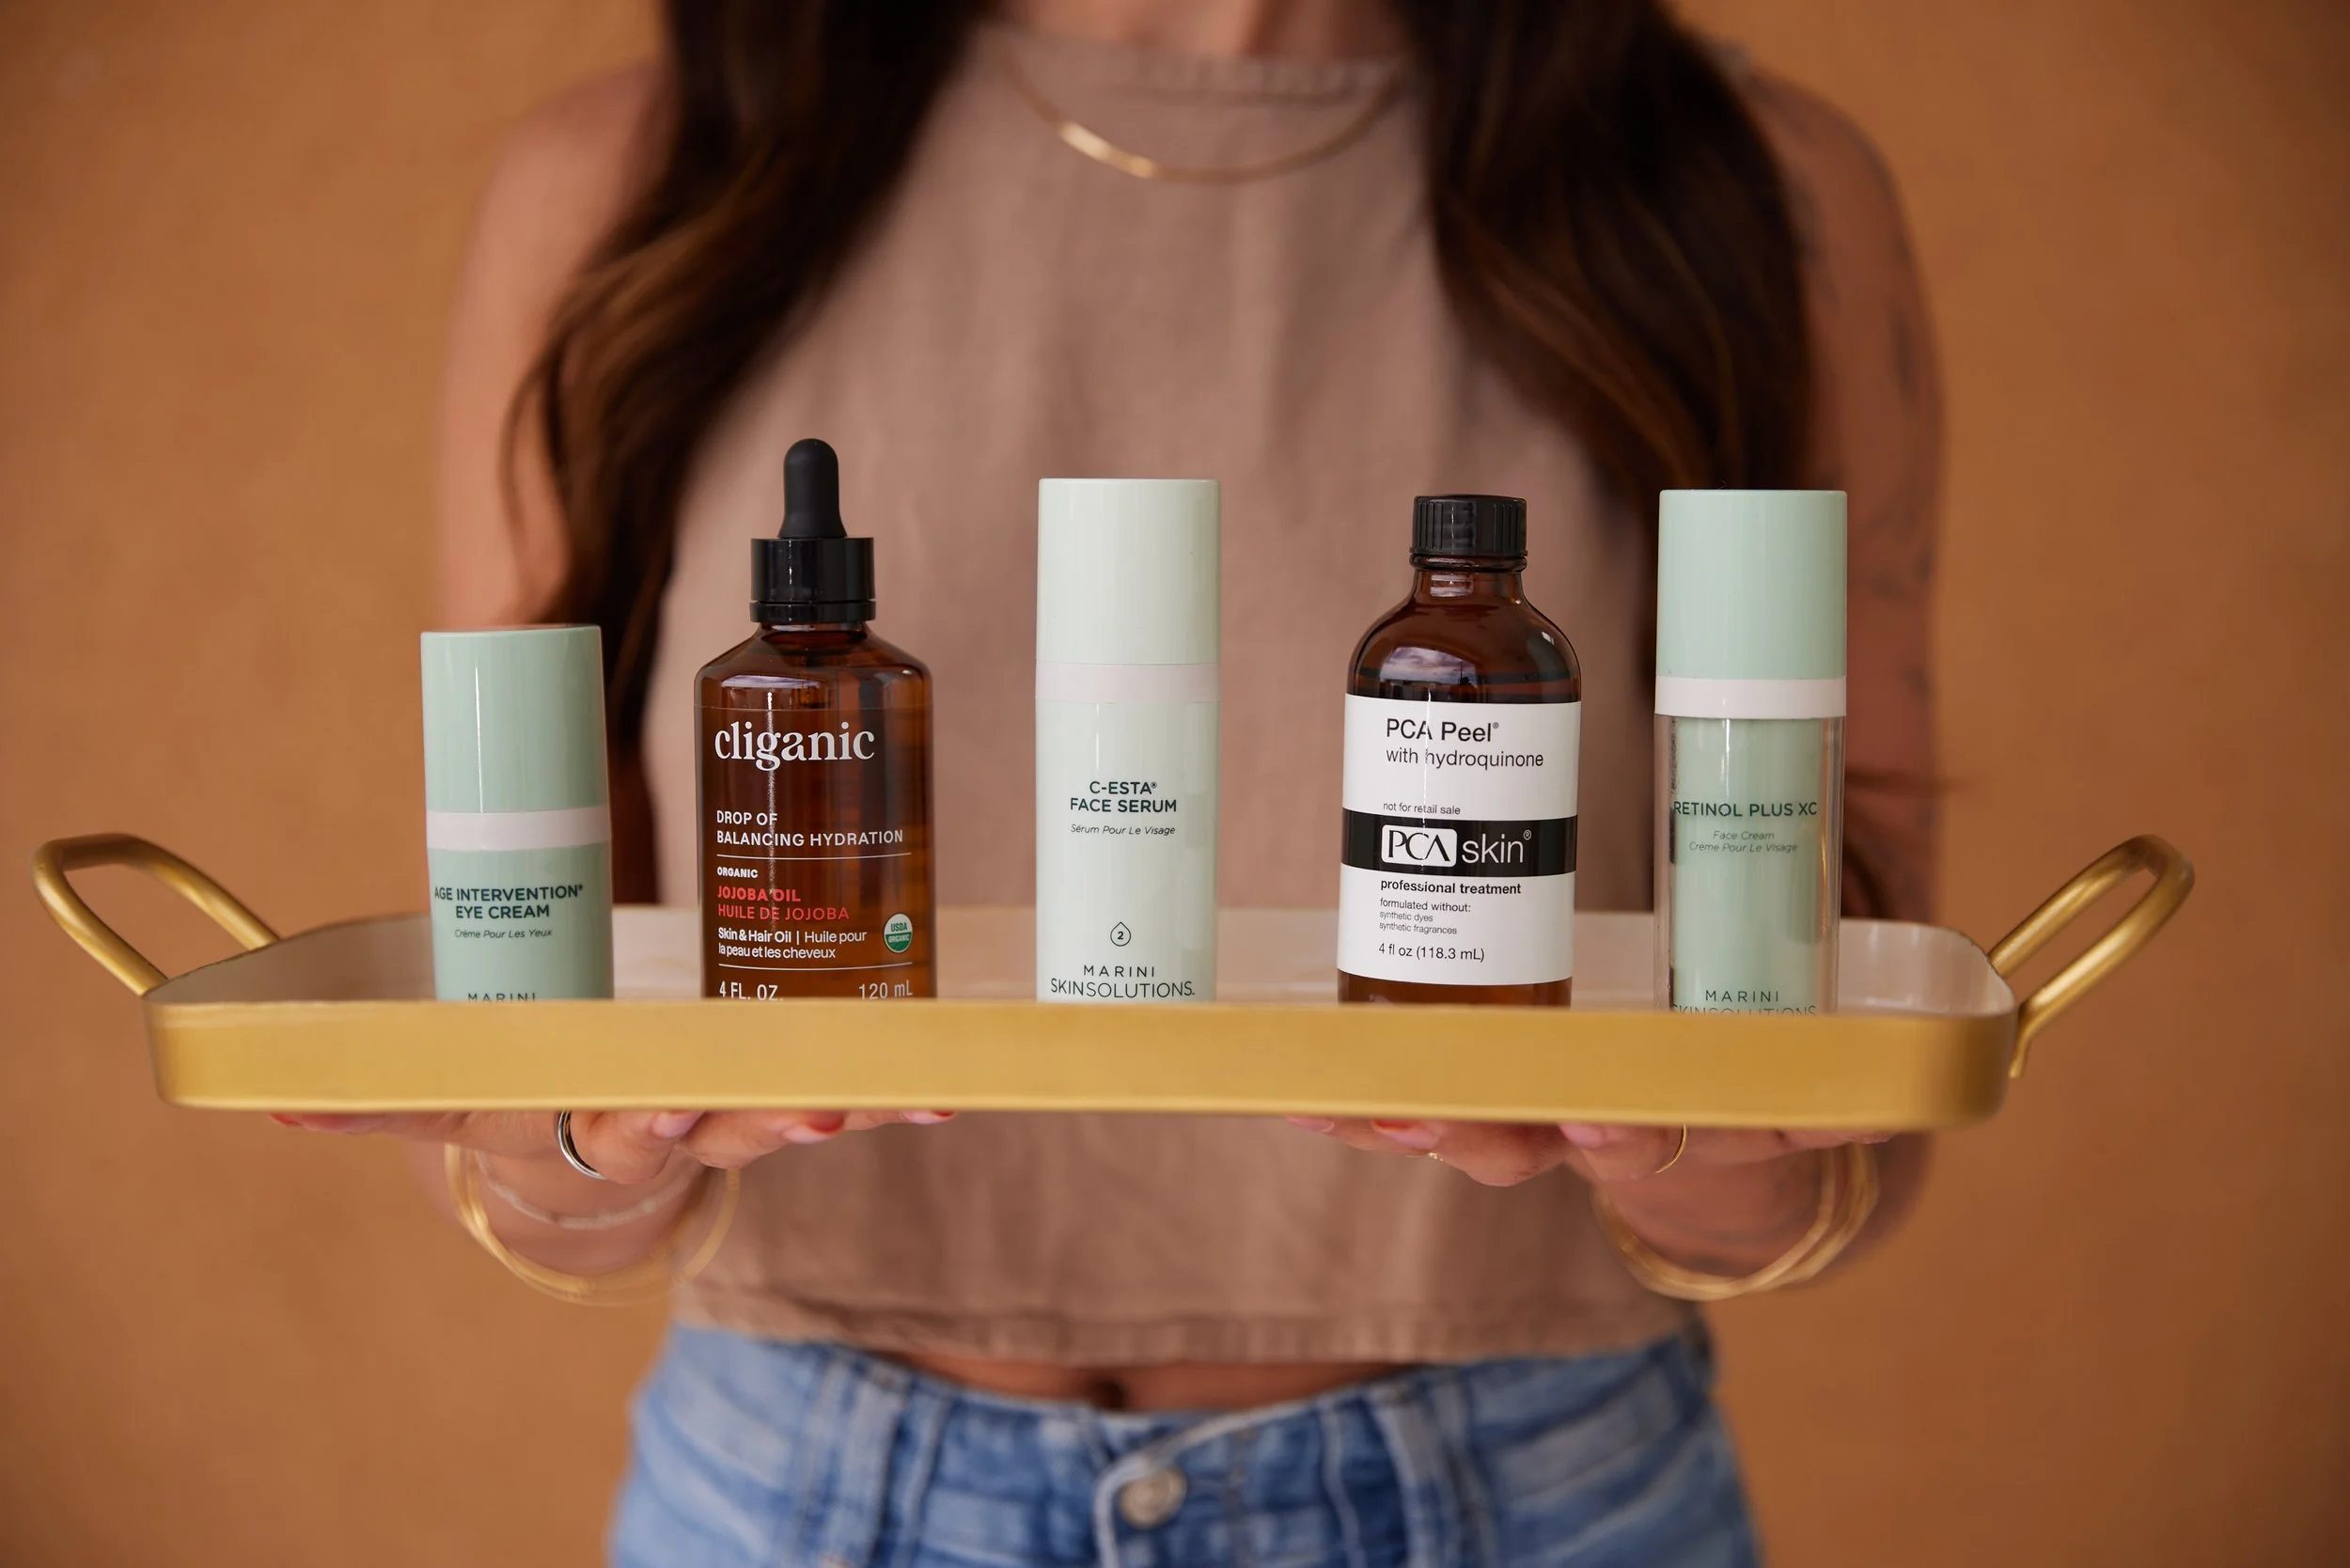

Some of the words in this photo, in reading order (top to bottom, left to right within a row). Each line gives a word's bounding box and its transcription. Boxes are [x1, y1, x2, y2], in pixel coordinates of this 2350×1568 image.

[1386, 717, 1433, 741] PCA
[1441, 721, 1499, 742] Peel®
[714, 721, 875, 771] cliganic
[1386, 746, 1418, 763] with
[1425, 748, 1543, 770] hydroquinone
[1089, 781, 1157, 795] C-ESTA®
[1071, 797, 1112, 812] FACE
[1118, 799, 1177, 813] SERUM
[1383, 802, 1397, 811] not
[1399, 802, 1411, 812] for
[1414, 804, 1437, 814] retail
[1440, 805, 1461, 815] sale
[1673, 801, 1743, 817] RETINOL
[1749, 803, 1793, 817] PLUS
[1798, 802, 1817, 815] XC
[716, 810, 752, 825] DROP
[756, 812, 777, 826] OF
[1071, 823, 1099, 834] Sérum
[1103, 824, 1126, 835] Pour
[1128, 825, 1141, 835] Le
[1145, 825, 1176, 837] Visage
[1714, 830, 1737, 840] Face
[1741, 831, 1775, 840] Cream
[716, 830, 805, 847] BALANCING
[810, 829, 903, 846] HYDRATION
[1388, 829, 1450, 862] PCA
[1462, 829, 1532, 864] skin®
[1722, 842, 1746, 853] Pour
[1749, 843, 1762, 853] Le
[1766, 843, 1798, 854] Visage
[717, 866, 759, 879] ORGANIC
[434, 886, 453, 901] AGE
[717, 886, 768, 902] JOJOBA
[772, 888, 801, 902] OIL
[1381, 880, 1455, 893] professional
[1460, 883, 1521, 895] treatment
[456, 905, 483, 919] EYE
[488, 904, 550, 919] CREAM
[718, 903, 755, 919] HUILE
[760, 906, 780, 920] DE
[785, 906, 850, 921] JOJOBA
[1380, 898, 1428, 910] formulated
[1431, 902, 1471, 912] without:
[1379, 911, 1411, 920] synthetic
[1414, 913, 1434, 923] dyes
[483, 929, 505, 938] Pour
[509, 929, 525, 938] Les
[529, 928, 552, 937] Yeux
[890, 921, 908, 933] USDA
[1379, 922, 1411, 932] synthetic
[1414, 924, 1457, 934] fragrances
[718, 927, 738, 941] Skin
[738, 929, 747, 941] &
[748, 930, 773, 943] Hair
[774, 931, 791, 943] Oil
[805, 930, 838, 943] Huile
[839, 931, 867, 945] pour
[888, 933, 910, 944] ORGANIC
[1117, 931, 1124, 940] 2
[718, 942, 726, 954] la
[727, 943, 750, 957] peau
[751, 946, 763, 958] et
[764, 946, 781, 958] les
[782, 947, 836, 959] cheveux
[1379, 943, 1385, 954] 4
[1388, 943, 1395, 955] fl
[1399, 947, 1412, 957] oz
[1417, 946, 1456, 960] (118.3
[1460, 948, 1484, 963] mL)
[1084, 964, 1154, 978] MARINI
[719, 980, 727, 997] 4
[730, 981, 751, 1000] FL.
[858, 982, 888, 999] 120
[894, 980, 914, 997] mL
[1705, 990, 1778, 1003] MARINI
